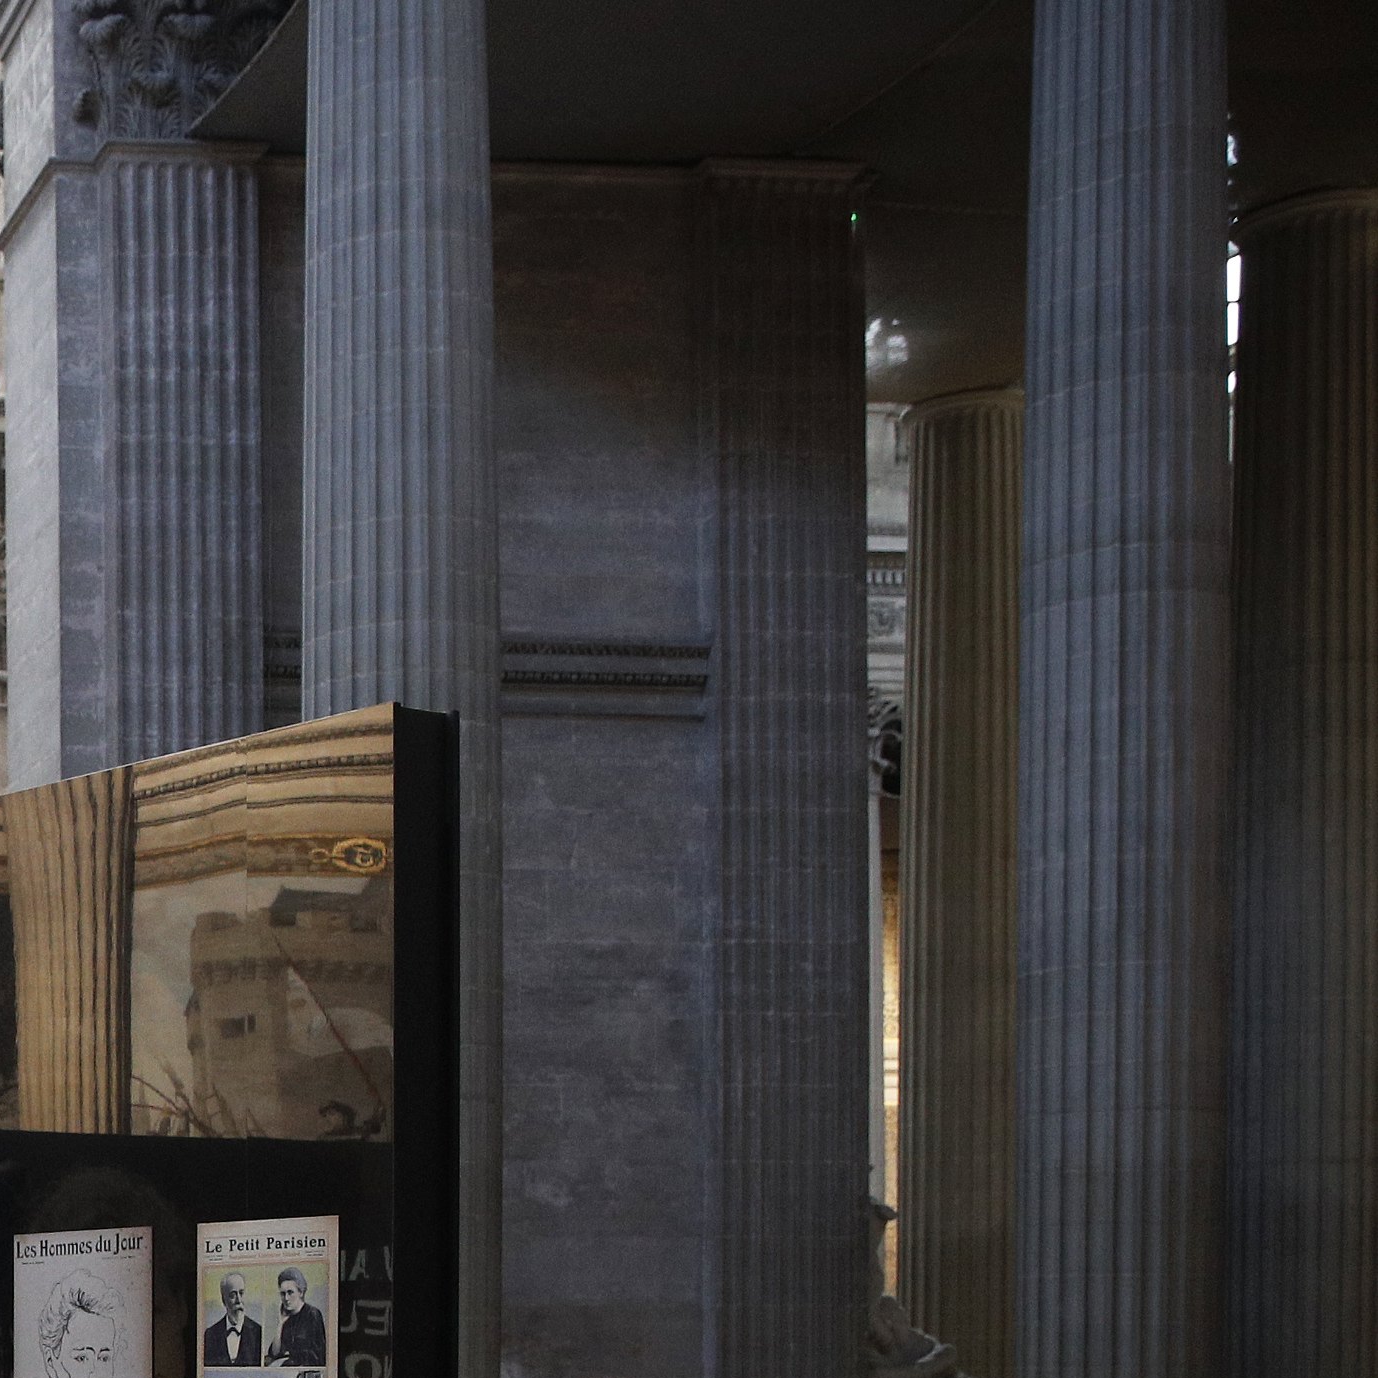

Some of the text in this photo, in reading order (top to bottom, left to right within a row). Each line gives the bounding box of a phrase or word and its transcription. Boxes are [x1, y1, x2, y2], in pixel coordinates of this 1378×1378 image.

[16, 1233, 143, 1260] Les Hommes du Jour
[205, 1236, 326, 1253] Le Petit Parisien
